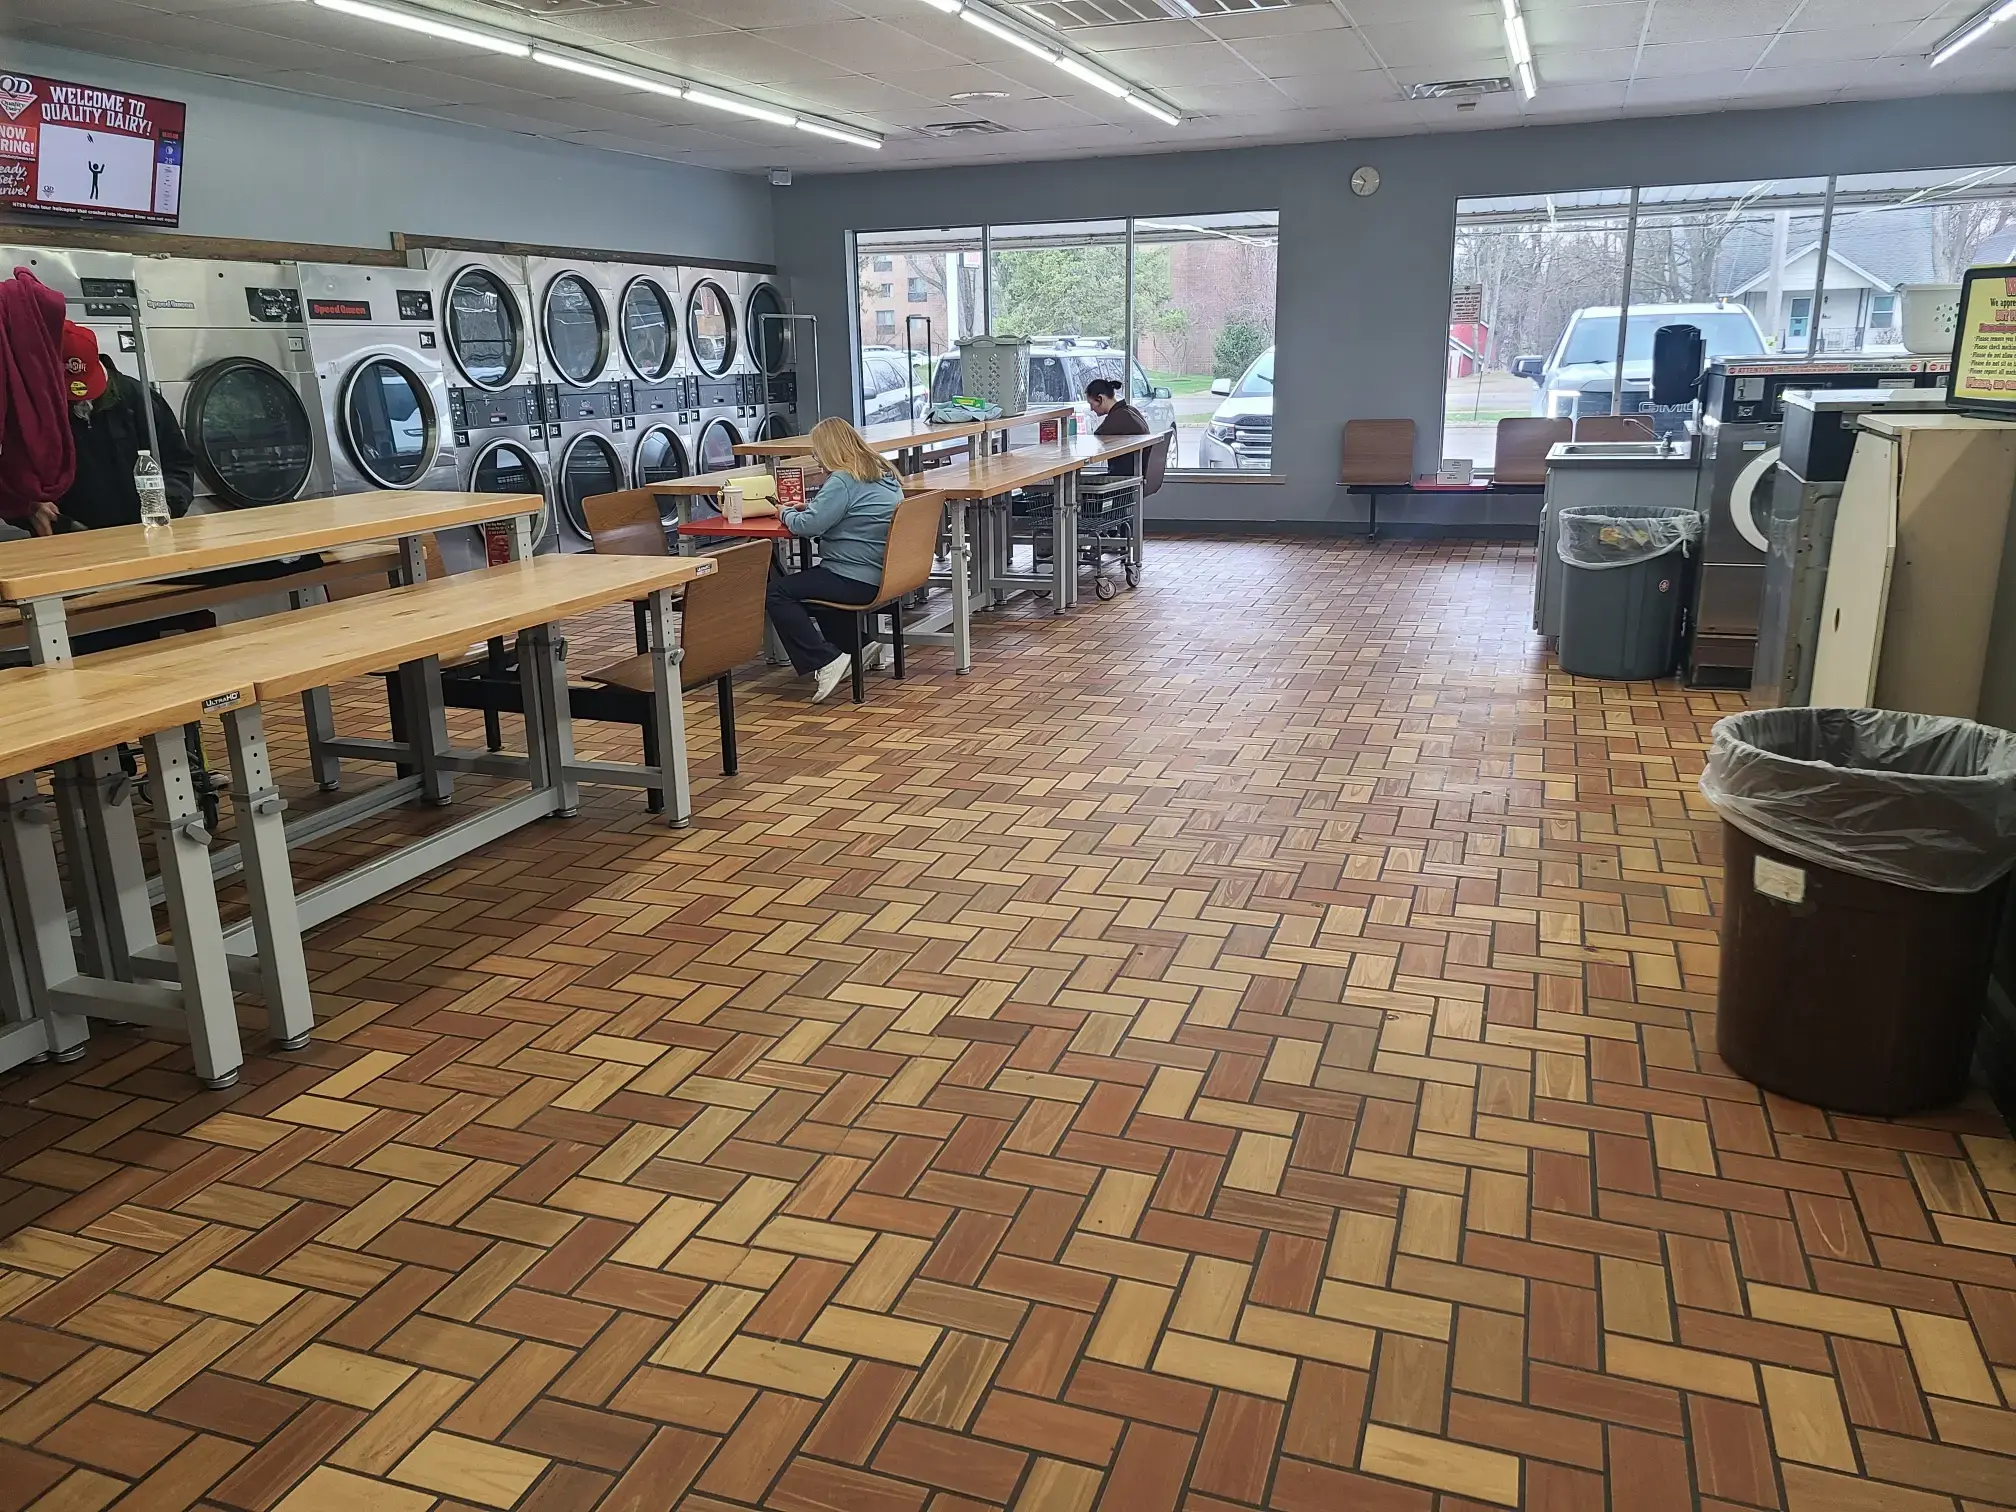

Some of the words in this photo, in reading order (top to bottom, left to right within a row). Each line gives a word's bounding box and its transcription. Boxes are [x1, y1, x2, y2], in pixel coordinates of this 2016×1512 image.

[50, 86, 125, 112] WELCOME
[128, 98, 145, 118] TO
[41, 103, 102, 125] QUALITY
[106, 110, 152, 136] DAIRY!
[146, 299, 170, 309] Speed
[171, 300, 195, 309] Queen
[313, 304, 340, 315] Speed
[340, 304, 366, 315] Queen
